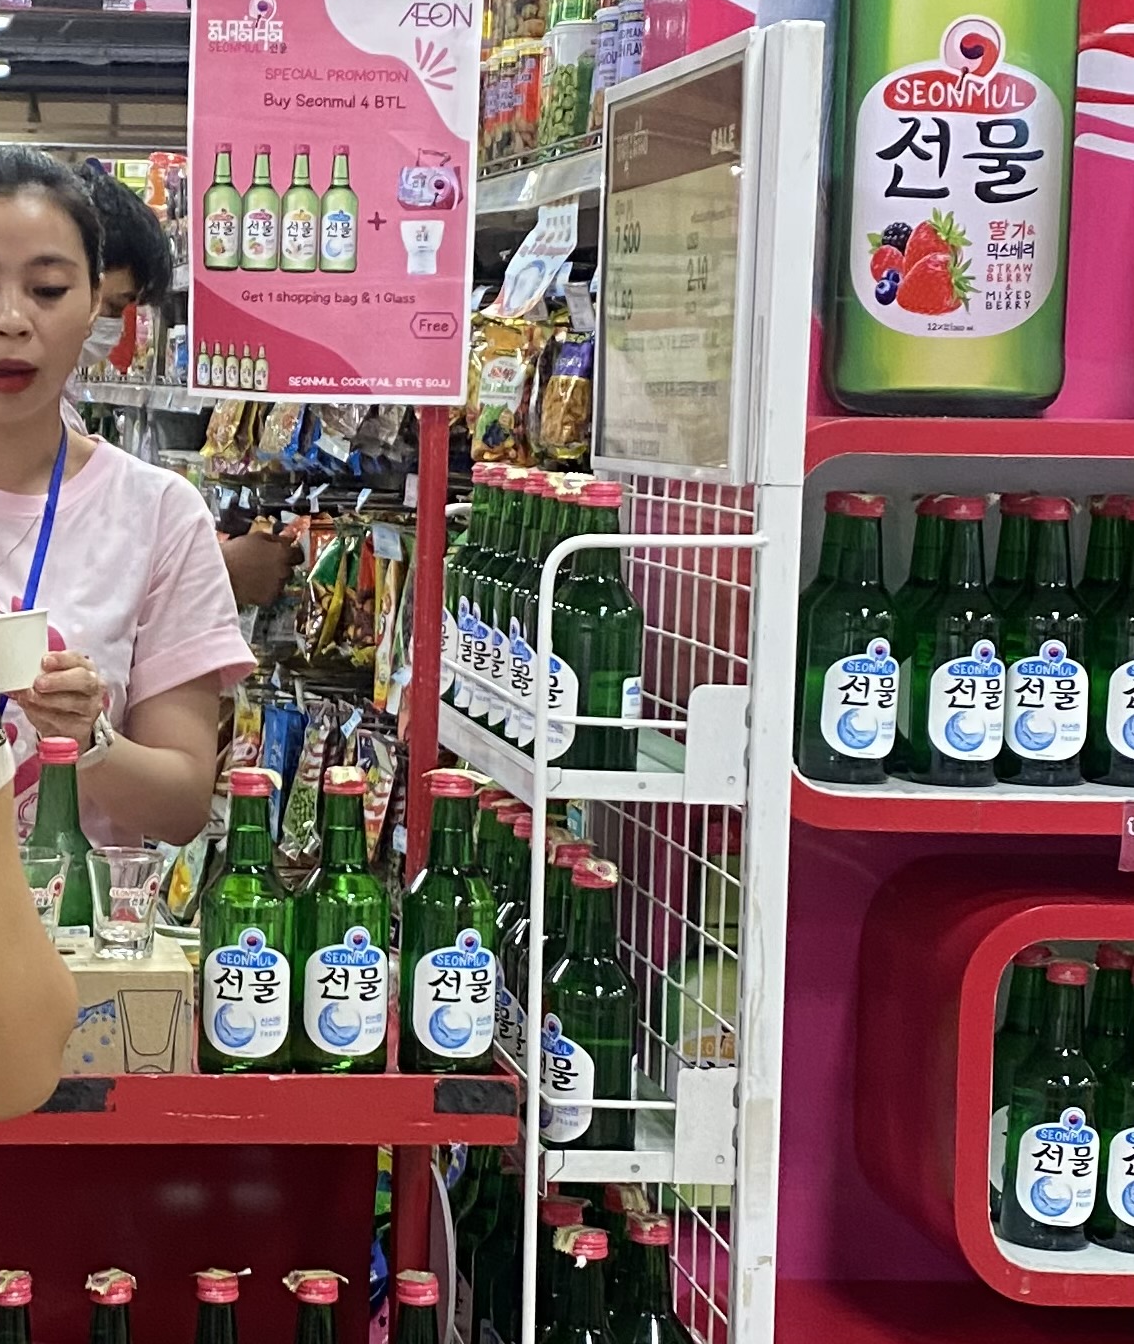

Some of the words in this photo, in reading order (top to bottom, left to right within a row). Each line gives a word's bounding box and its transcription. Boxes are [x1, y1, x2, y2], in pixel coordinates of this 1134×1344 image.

[265, 67, 323, 81] SPECIAL
[326, 69, 409, 83] PROMOTION
[893, 78, 1025, 109] SEONMUL
[263, 94, 291, 109] Buy
[295, 94, 356, 109] Seonmul
[360, 95, 370, 108] 4
[374, 94, 407, 109] BTL
[875, 116, 1044, 204] 선물
[986, 263, 1033, 273] STRAW
[986, 273, 1032, 283] BERRY
[241, 290, 265, 304] Get
[276, 291, 331, 306] shopping
[334, 291, 358, 306] bag
[383, 291, 416, 305] Glass
[985, 291, 1032, 301] MIXED
[985, 300, 1031, 310] BERRY
[418, 319, 450, 333] Free
[288, 376, 338, 388] SEONMUL
[425, 378, 451, 389] SOJU
[219, 952, 274, 966] SEONMUL
[324, 951, 376, 965] SEONMUL
[435, 953, 487, 967] SEONMUL
[213, 967, 281, 1004] 선물
[317, 967, 383, 1001] 선물
[428, 969, 492, 1004] 선물
